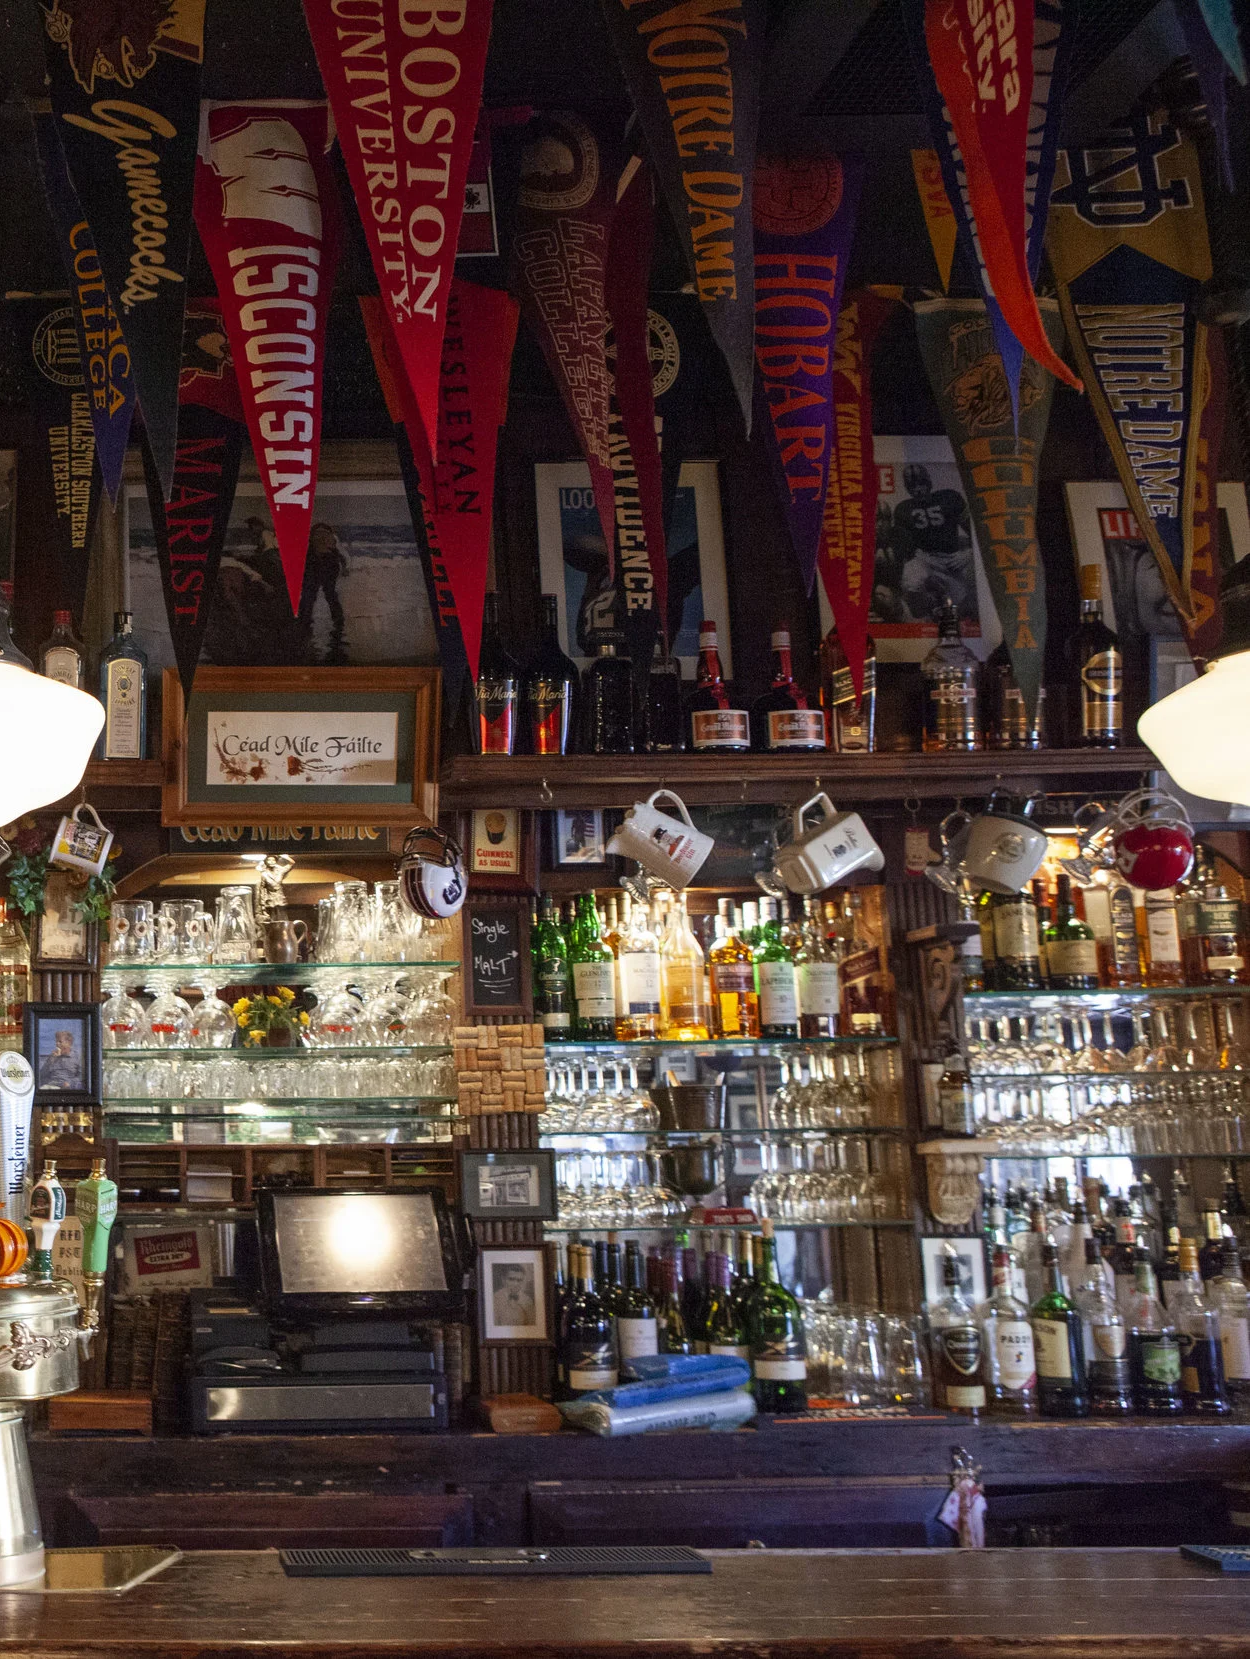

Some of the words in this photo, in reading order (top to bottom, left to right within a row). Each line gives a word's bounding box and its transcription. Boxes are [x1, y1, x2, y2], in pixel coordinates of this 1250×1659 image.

[636, 0, 747, 158] NOTRE
[61, 99, 184, 304] Gamecocks
[398, 0, 467, 322] BOSTON
[682, 170, 744, 301] DAME
[754, 253, 838, 504] HOBART
[1075, 303, 1186, 413] NOTRE
[835, 402, 863, 496] VIRGINIA
[1118, 419, 1184, 519] DAME
[71, 479, 92, 549] SOUTHERN
[163, 437, 228, 626] MARIST
[842, 501, 863, 607] MILITARY
[911, 503, 943, 527] 35
[961, 437, 1037, 649] COLUMBIA
[222, 734, 271, 756] Céad
[274, 735, 320, 757] Míle
[324, 736, 383, 758] Fáilte
[476, 848, 514, 859] GUINNESS
[478, 859, 489, 867] AS
[490, 859, 511, 867] USUAL
[472, 917, 510, 943] Single
[473, 955, 511, 976] MALT
[8, 1123, 26, 1196] Warsteiner
